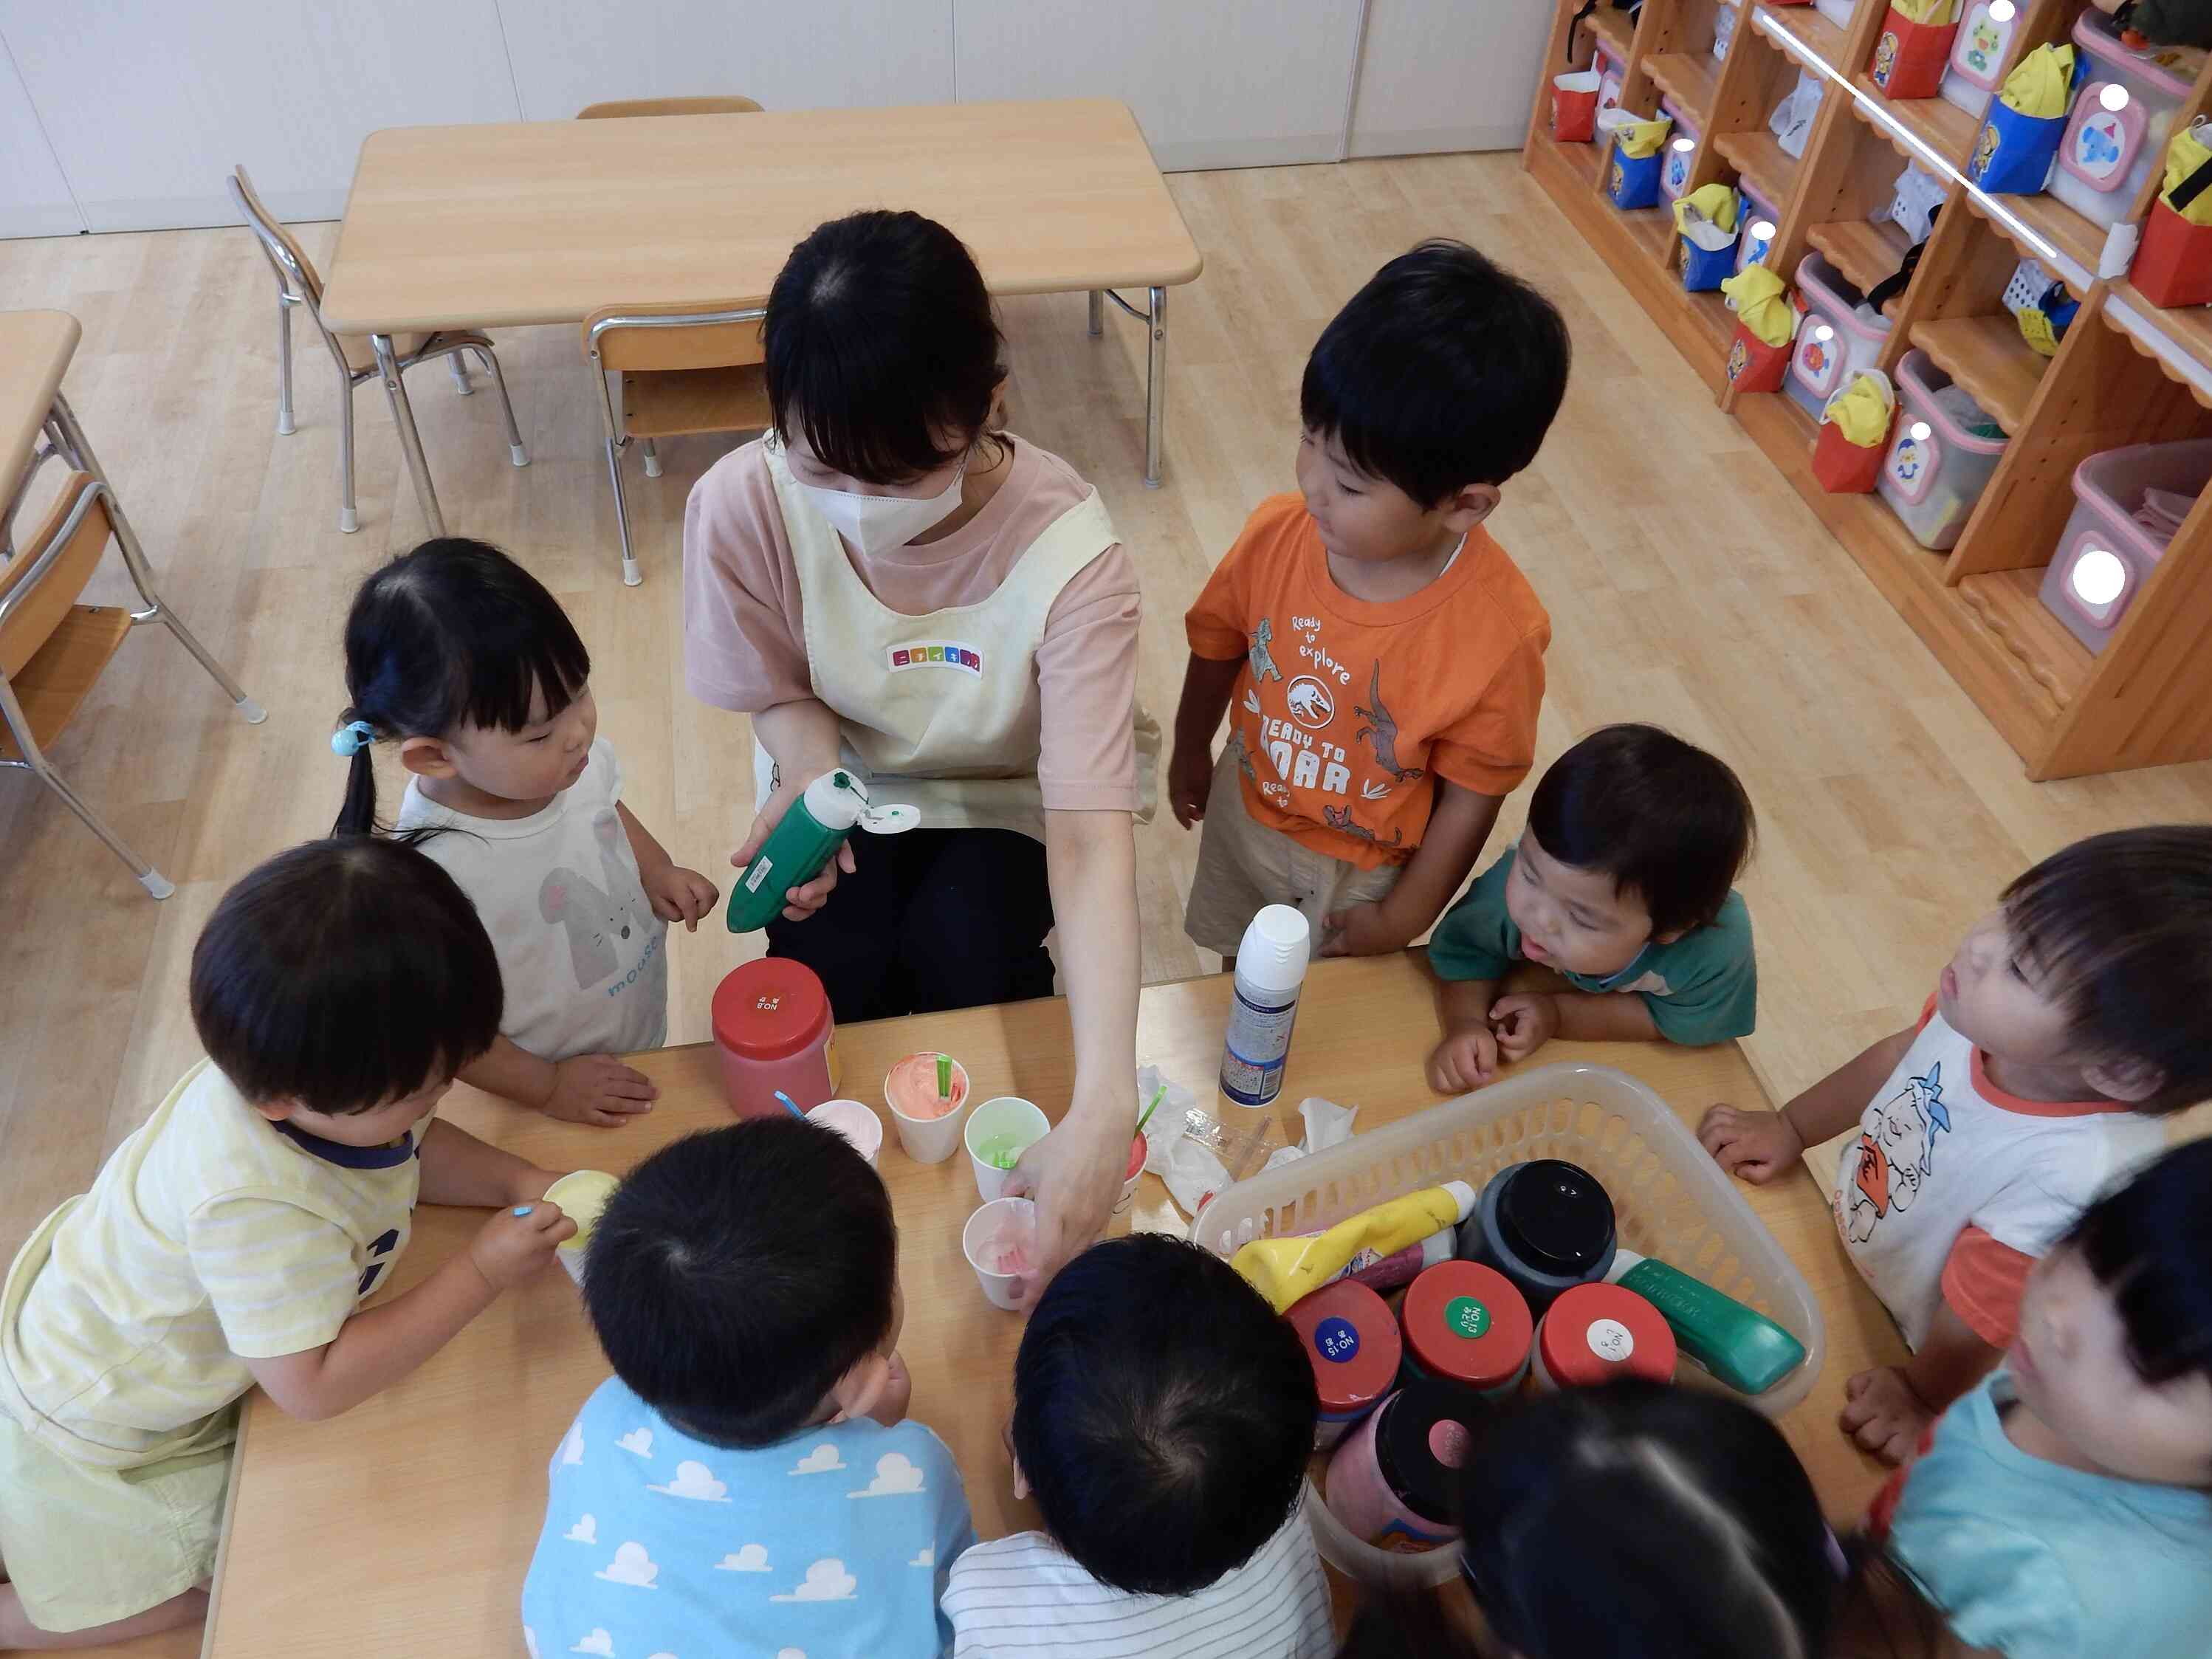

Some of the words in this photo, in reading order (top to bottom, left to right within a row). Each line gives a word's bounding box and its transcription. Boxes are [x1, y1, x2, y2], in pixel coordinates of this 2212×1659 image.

[1292, 616, 1321, 632] Ready
[1305, 631, 1316, 644] to
[1299, 645, 1351, 685] explore
[1322, 741, 1346, 763] TO
[1277, 796, 1288, 808] to
[1467, 1306, 1482, 1333] NO.13
[1327, 1336, 1355, 1356] NO.15
